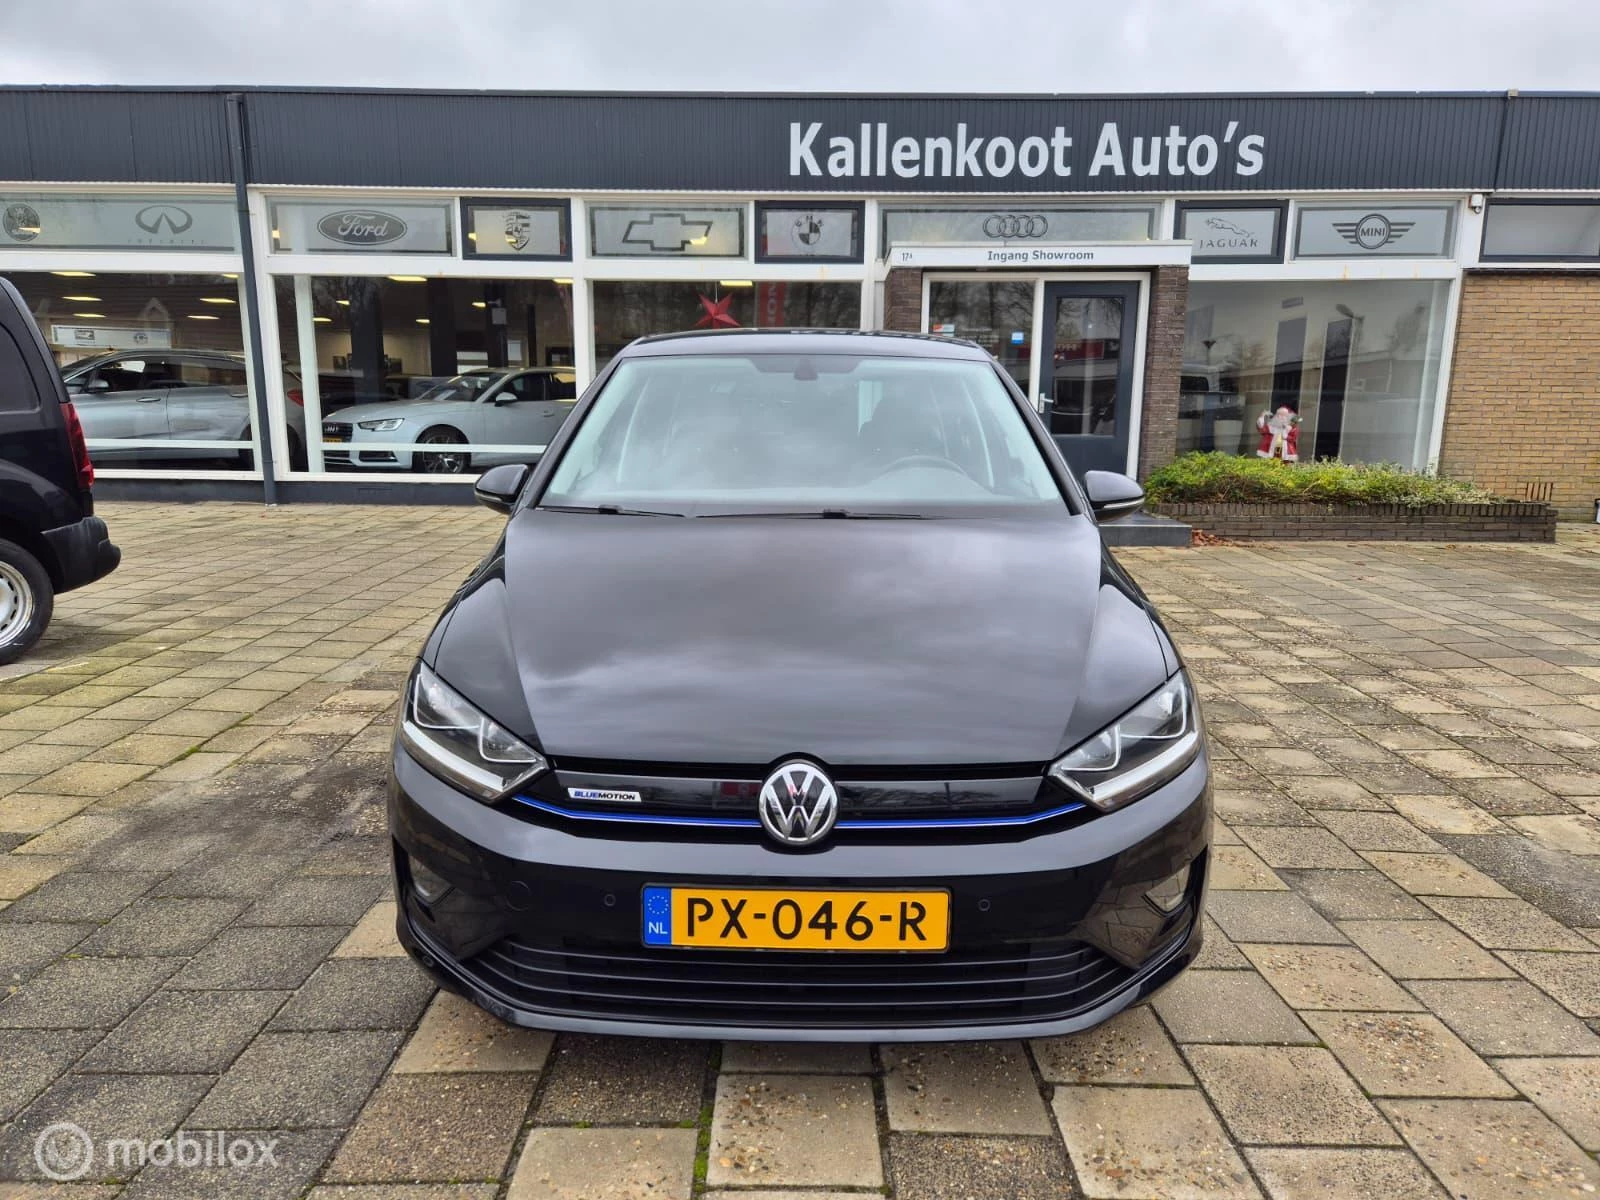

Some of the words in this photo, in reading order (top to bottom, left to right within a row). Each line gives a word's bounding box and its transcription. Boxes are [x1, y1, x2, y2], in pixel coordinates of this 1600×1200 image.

[789, 122, 1073, 178] Kallenkoot
[338, 214, 388, 237] Ford
[1361, 227, 1385, 237] MINI
[1200, 238, 1258, 249] JAGUAR
[988, 251, 1029, 262] Ingang
[1031, 250, 1094, 261] Showroom
[573, 789, 637, 802] BLUEMOTION
[648, 922, 669, 936] NL
[686, 897, 928, 941] PX-046-R
